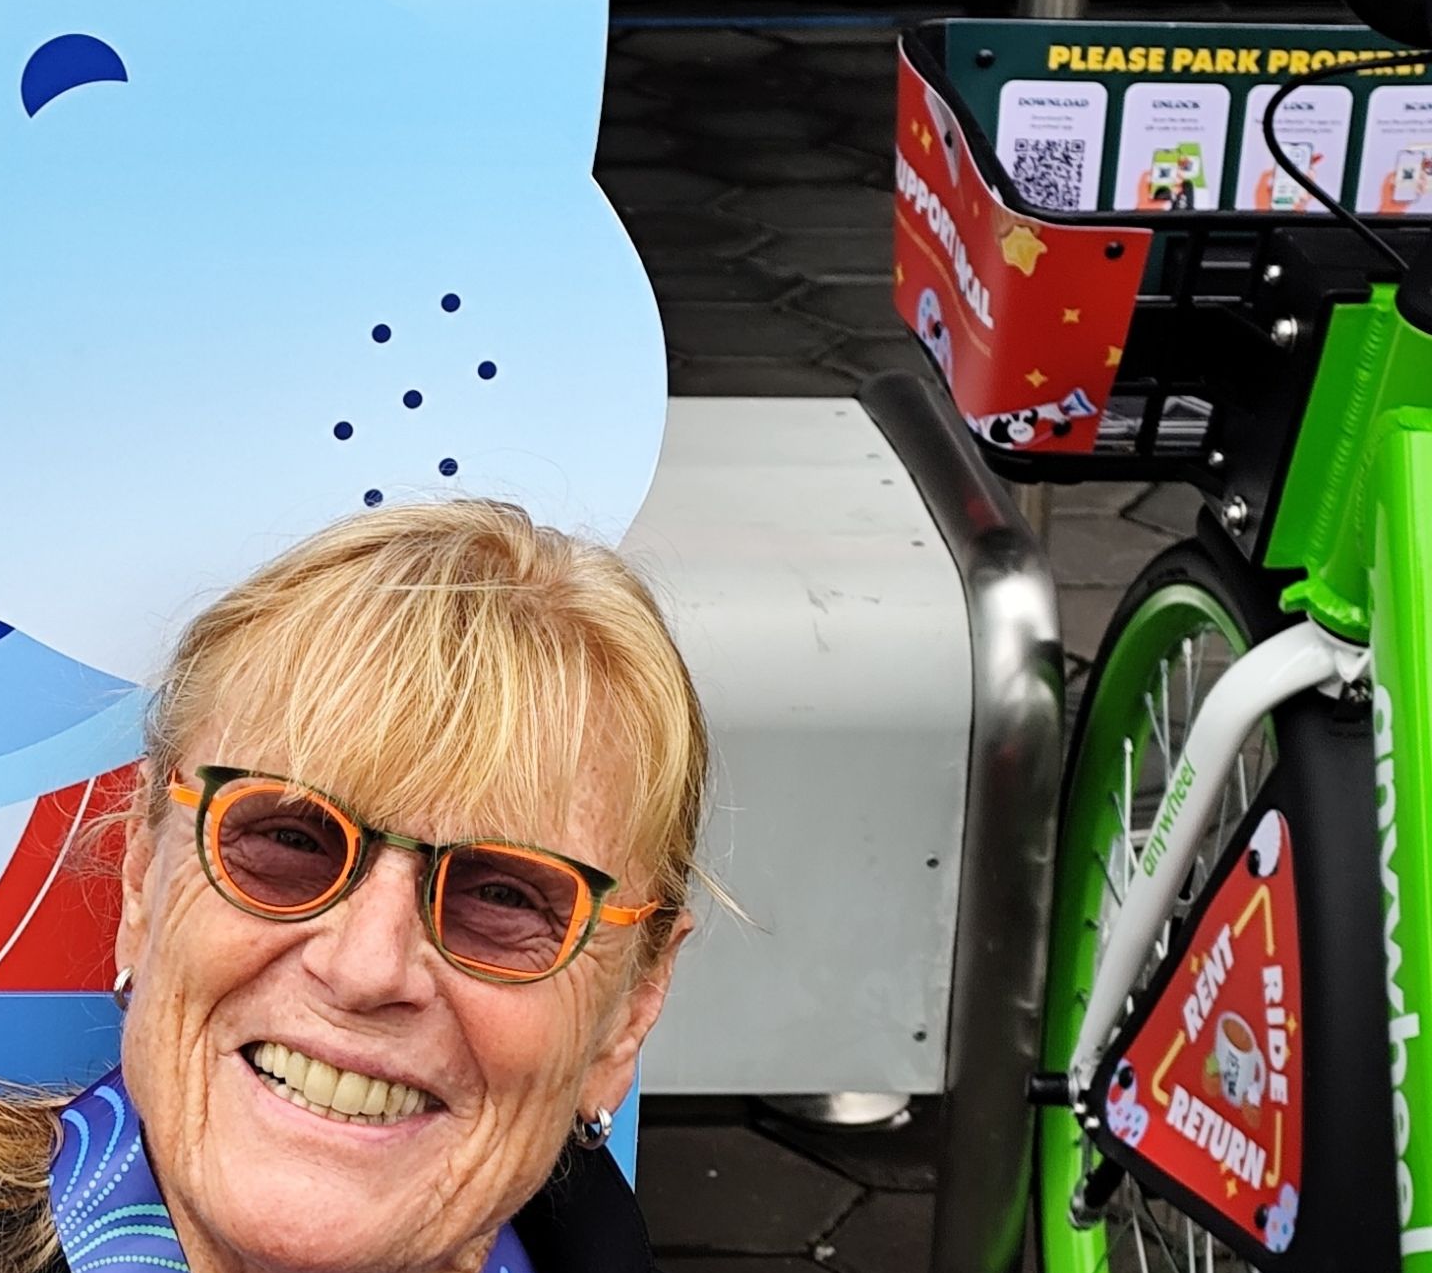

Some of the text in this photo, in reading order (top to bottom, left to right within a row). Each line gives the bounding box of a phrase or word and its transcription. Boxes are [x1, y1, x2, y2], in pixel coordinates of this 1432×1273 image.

[1048, 45, 1165, 71] PLEASE
[1172, 47, 1260, 74] PARK
[1143, 751, 1197, 878] anywheel
[1182, 923, 1235, 1044] RENT
[1262, 965, 1289, 1105] RIDE
[1165, 1083, 1266, 1191] RETURN
